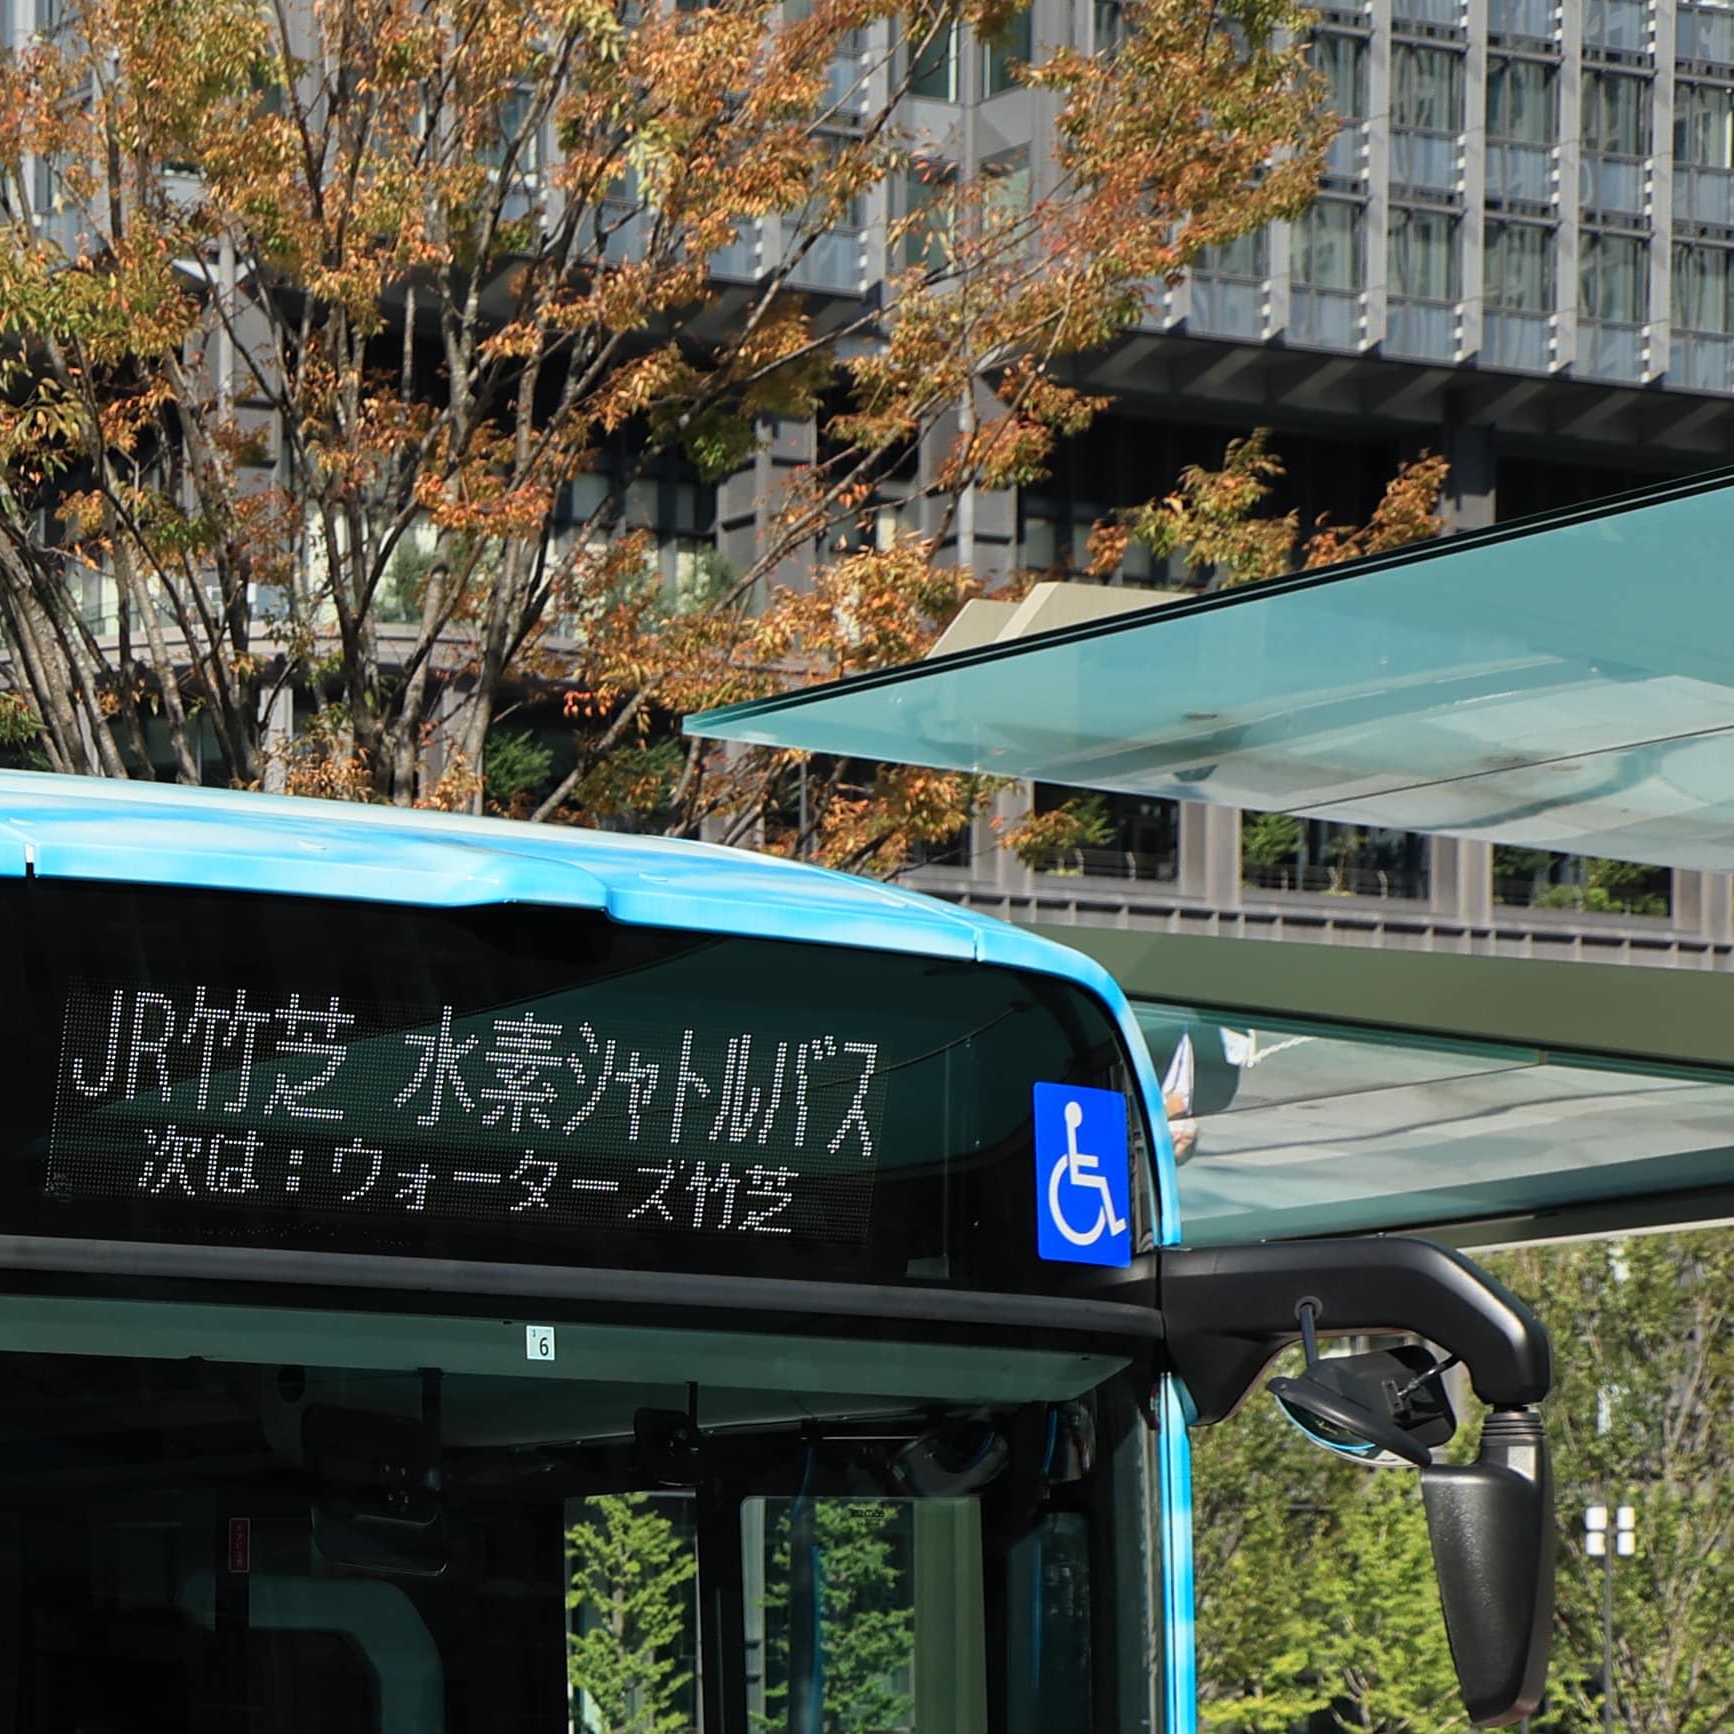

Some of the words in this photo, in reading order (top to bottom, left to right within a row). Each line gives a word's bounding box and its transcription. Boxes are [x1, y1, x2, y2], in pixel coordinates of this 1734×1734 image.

[72, 985, 356, 1116] JR竹芝
[393, 1004, 880, 1157] 水素シャトルバス
[539, 1336, 549, 1357] 6
